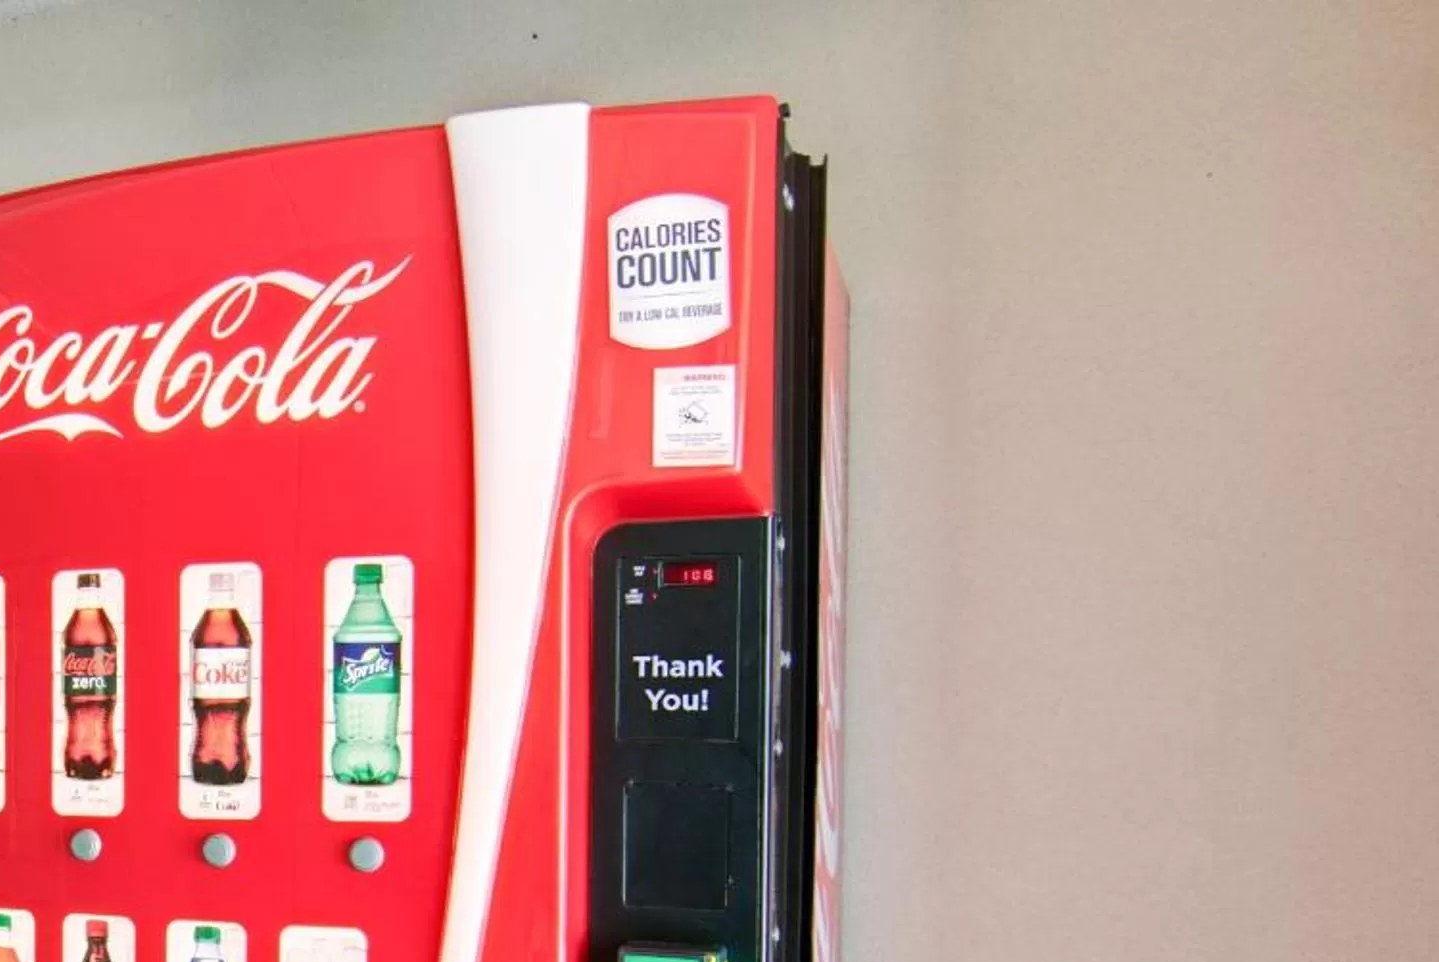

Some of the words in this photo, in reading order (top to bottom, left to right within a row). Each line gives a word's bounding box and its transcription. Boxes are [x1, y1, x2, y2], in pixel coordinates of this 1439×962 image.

[616, 218, 721, 252] CALORIES
[617, 247, 722, 289] COUNT
[192, 661, 249, 685] Coke
[344, 654, 392, 684] Sprite
[633, 654, 724, 678] Thank
[71, 676, 107, 690] zero
[645, 688, 710, 711] You!
